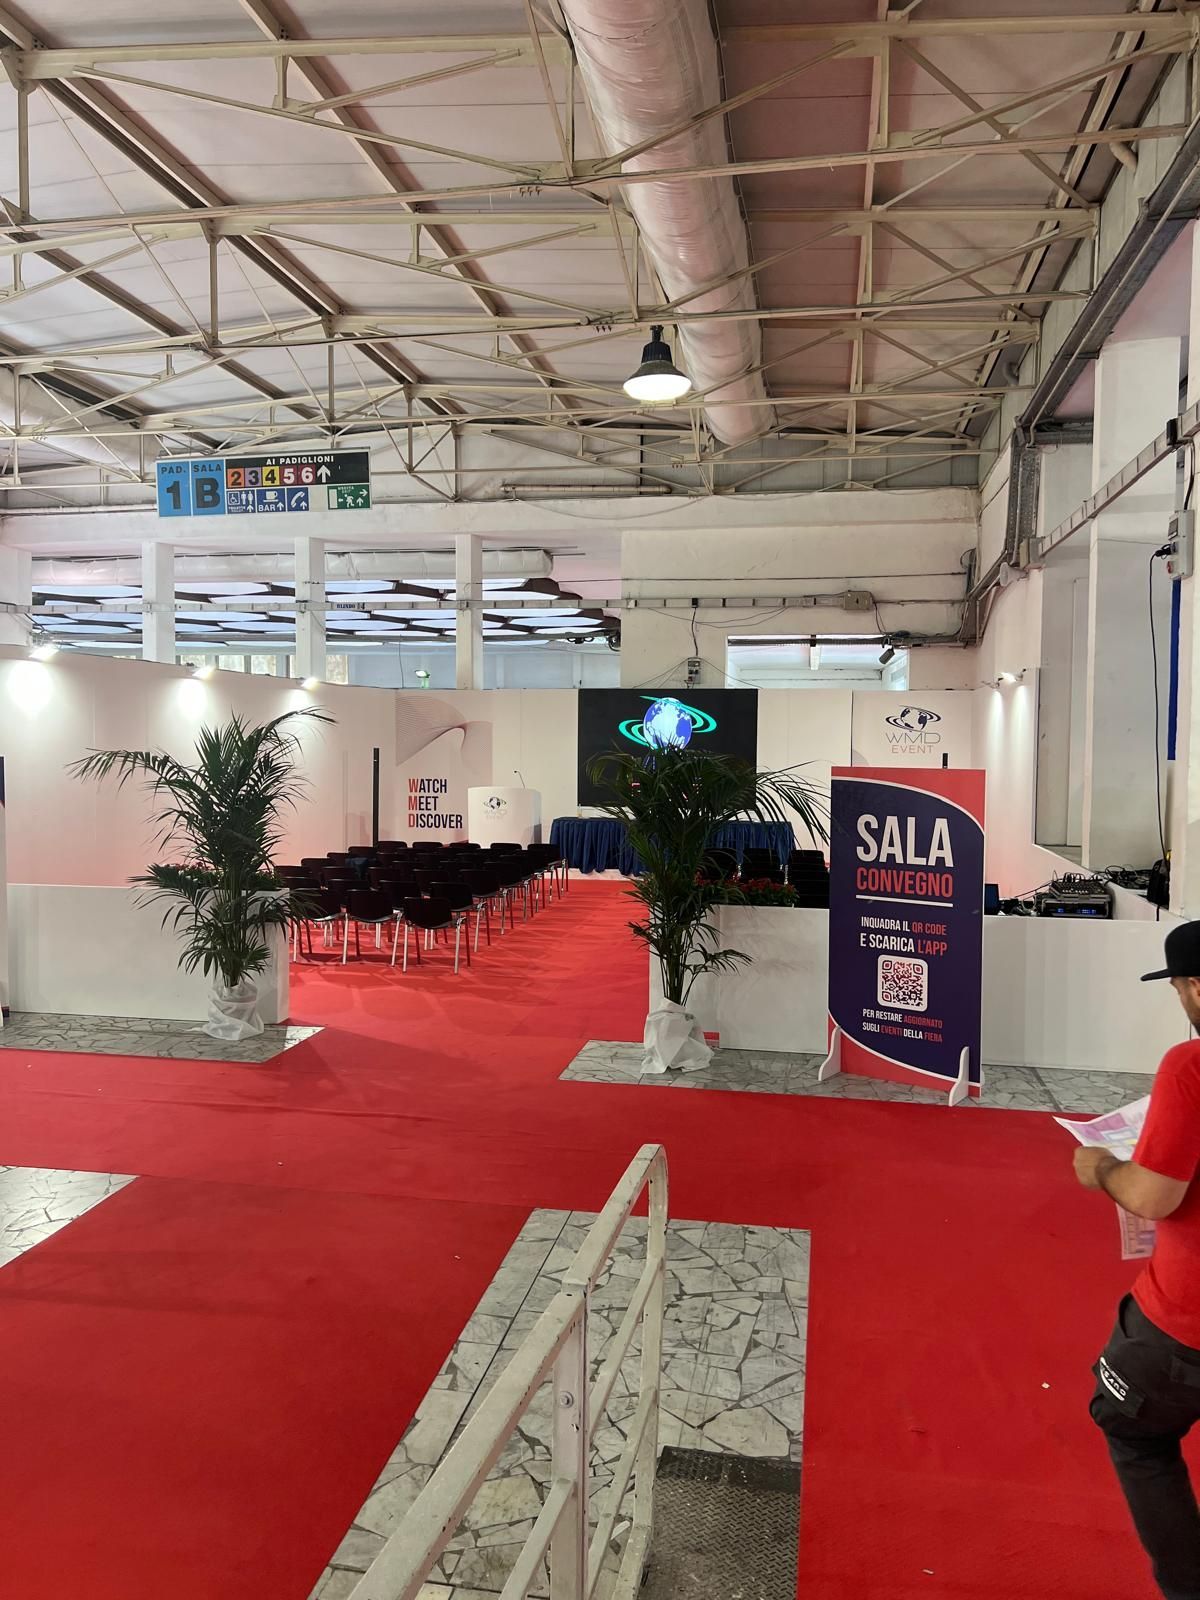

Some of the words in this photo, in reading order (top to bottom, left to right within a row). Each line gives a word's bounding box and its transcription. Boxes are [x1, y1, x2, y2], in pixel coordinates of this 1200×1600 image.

[193, 464, 222, 473] SALA
[280, 455, 334, 465] PADIGLIONI
[161, 465, 186, 474] PAD.
[230, 470, 242, 486] 2
[248, 470, 259, 485] 3
[265, 469, 276, 484] 4
[283, 468, 295, 484] 5
[301, 467, 313, 483] 6
[166, 480, 181, 510] 1
[195, 477, 220, 509] B
[258, 504, 276, 512] BAR
[885, 732, 941, 744] WMD
[892, 744, 934, 753] EVENT
[408, 778, 447, 793] WATCH
[408, 795, 439, 811] MEET
[408, 813, 463, 829] DISCOVER
[856, 813, 954, 868] SALA
[856, 867, 954, 898] CONVEGNO
[861, 915, 900, 931] INQUADRA
[902, 920, 910, 932] IL
[912, 921, 923, 934] QR
[925, 923, 947, 936] CODE
[860, 932, 867, 947] E
[869, 934, 915, 953] SCARICA
[917, 939, 948, 956] L'APP
[862, 1008, 874, 1019] PER
[876, 1010, 903, 1023] RESTARE
[903, 1015, 943, 1029] AGGIORNATO
[862, 1022, 880, 1033] SUGLI
[880, 1025, 902, 1036] EVENTI
[903, 1028, 923, 1040] DELLA
[924, 1032, 943, 1043] FIERA
